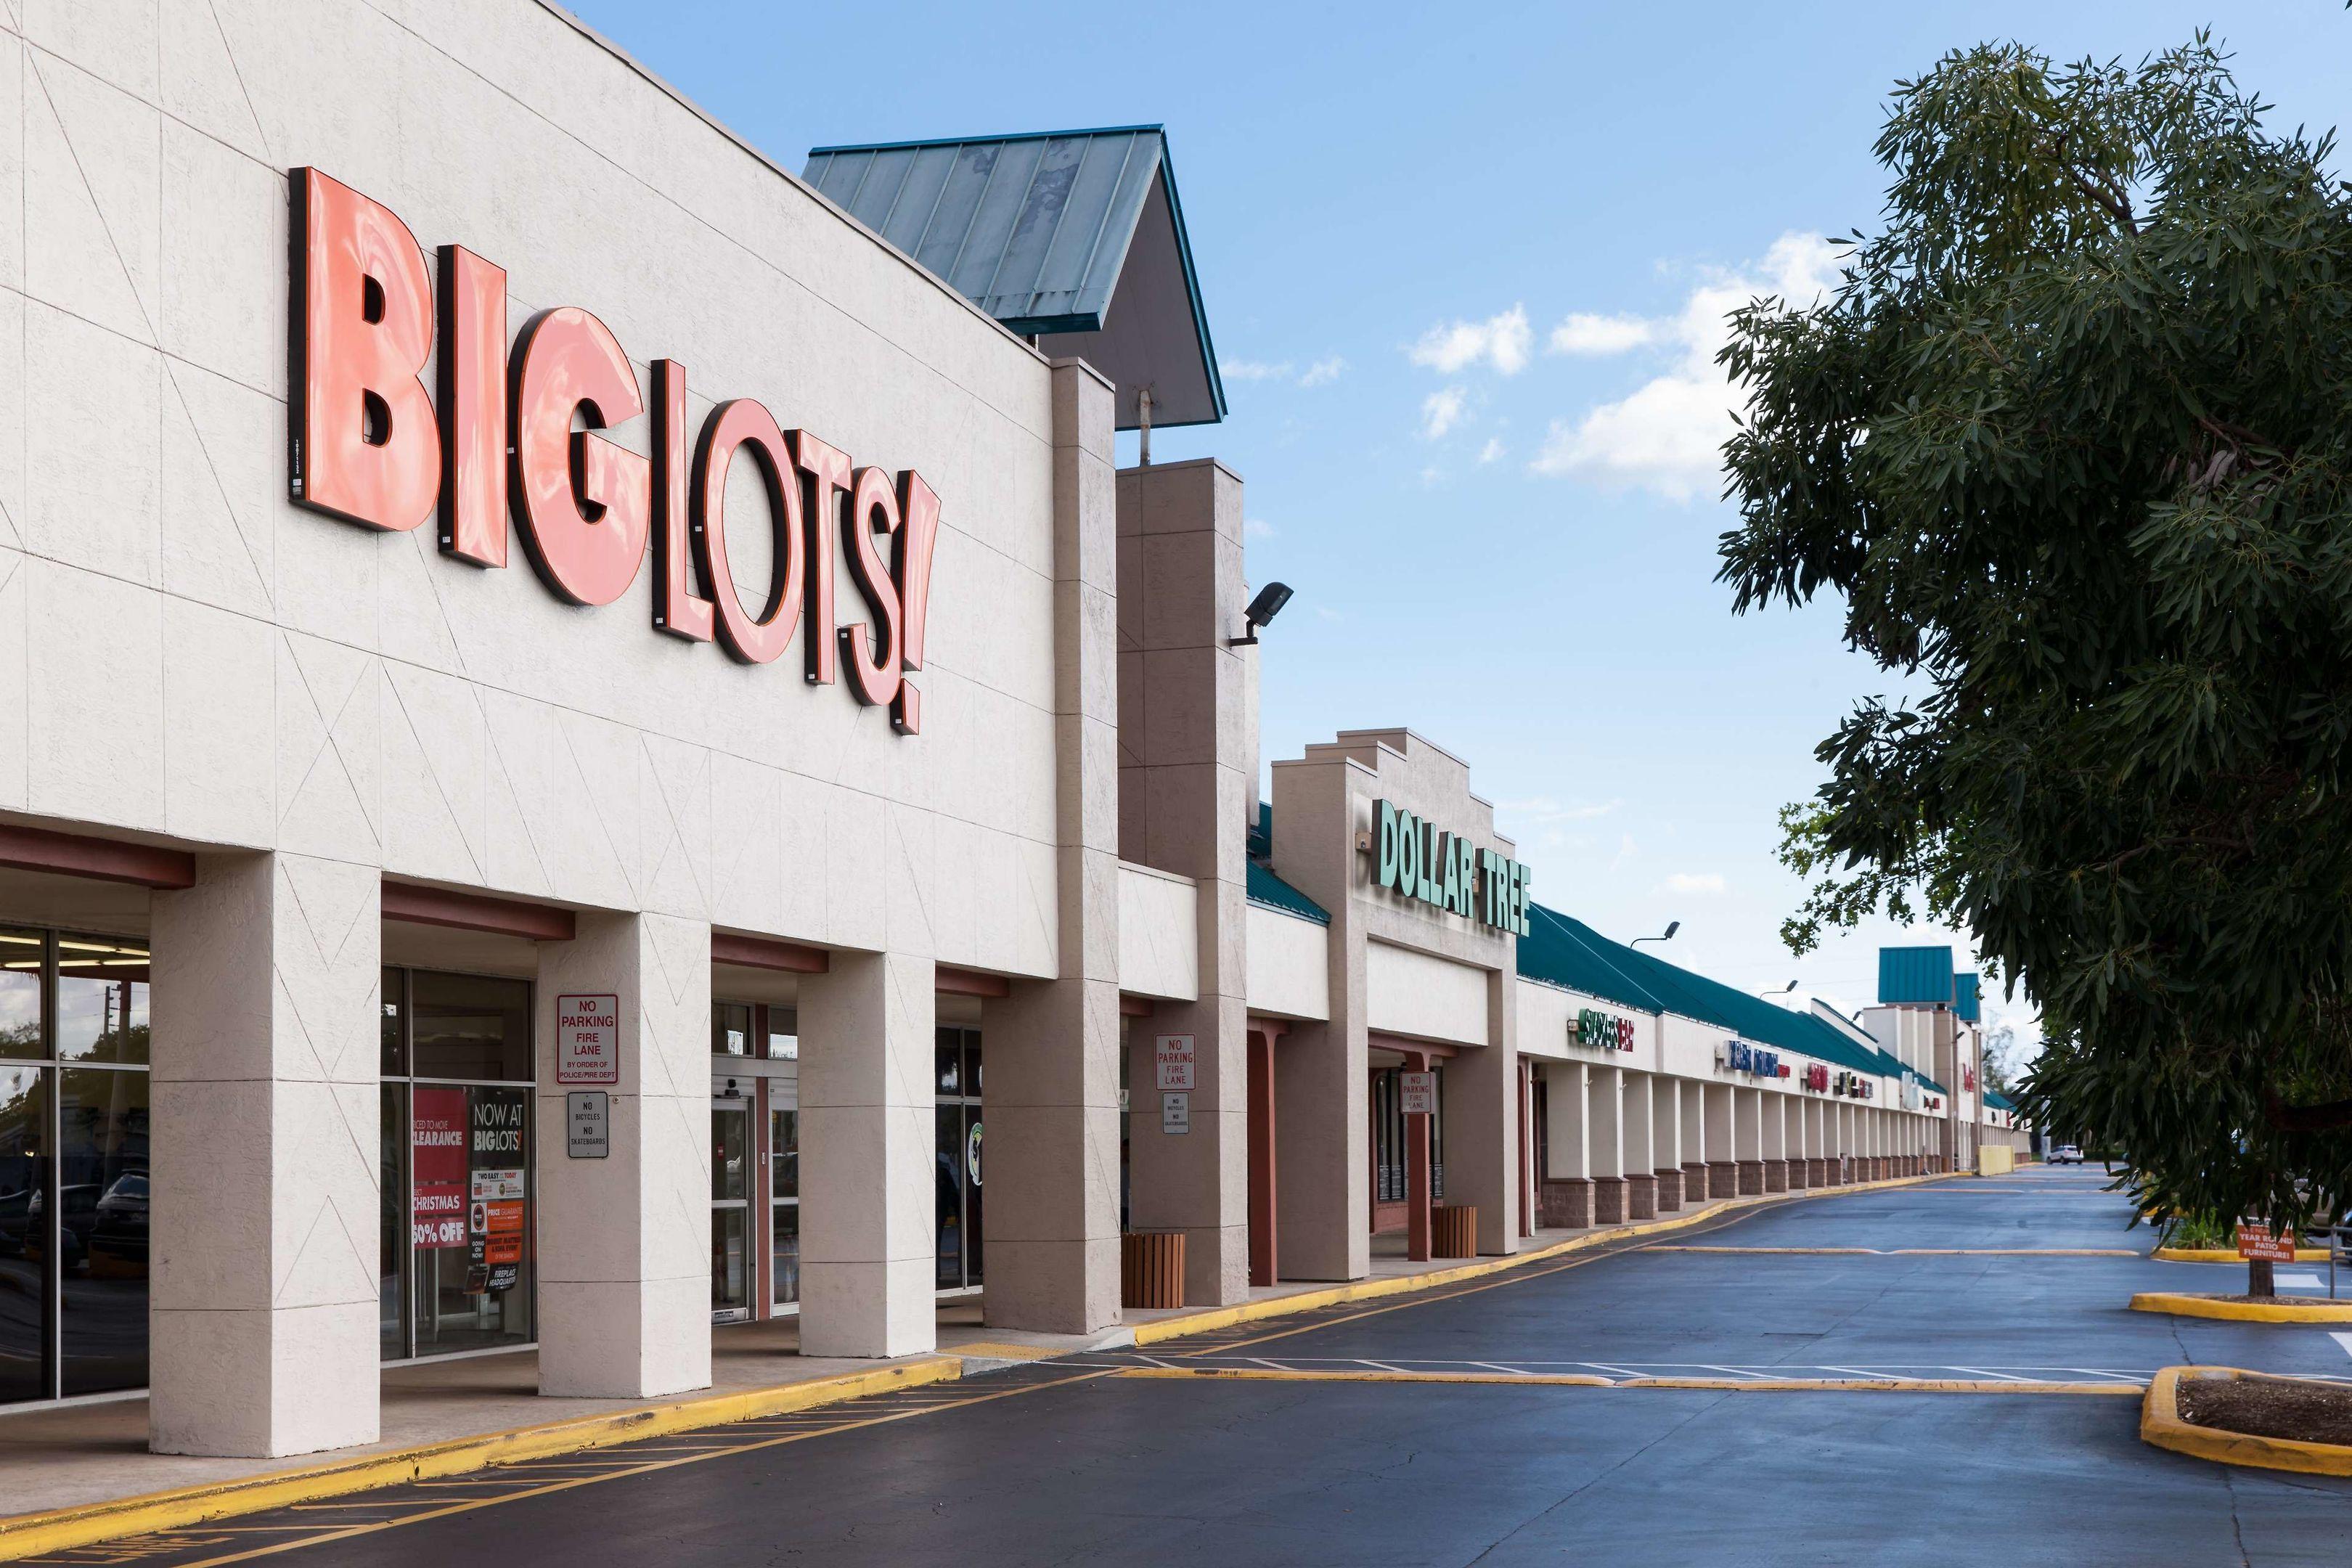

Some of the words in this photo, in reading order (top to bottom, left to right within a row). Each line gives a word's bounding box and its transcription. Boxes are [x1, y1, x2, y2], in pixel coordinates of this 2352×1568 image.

[1370, 799, 1474, 919] DOLLAR
[1474, 847, 1531, 938] TREE
[579, 1000, 596, 1012] NO
[562, 1016, 613, 1027] PARKING
[576, 1033, 599, 1042] FIRE
[574, 1045, 601, 1055] LANE
[1169, 1040, 1182, 1050] NO
[1159, 1053, 1193, 1063] PARKING
[1167, 1065, 1184, 1074] FIRE
[1165, 1076, 1186, 1085] LANE
[474, 1103, 507, 1126] NOW
[510, 1104, 523, 1126] AT
[427, 1120, 435, 1130] TO
[413, 1131, 462, 1146] LEARANCE
[439, 1222, 464, 1242] OFF
[2244, 1248, 2290, 1259] FURNITURE!
